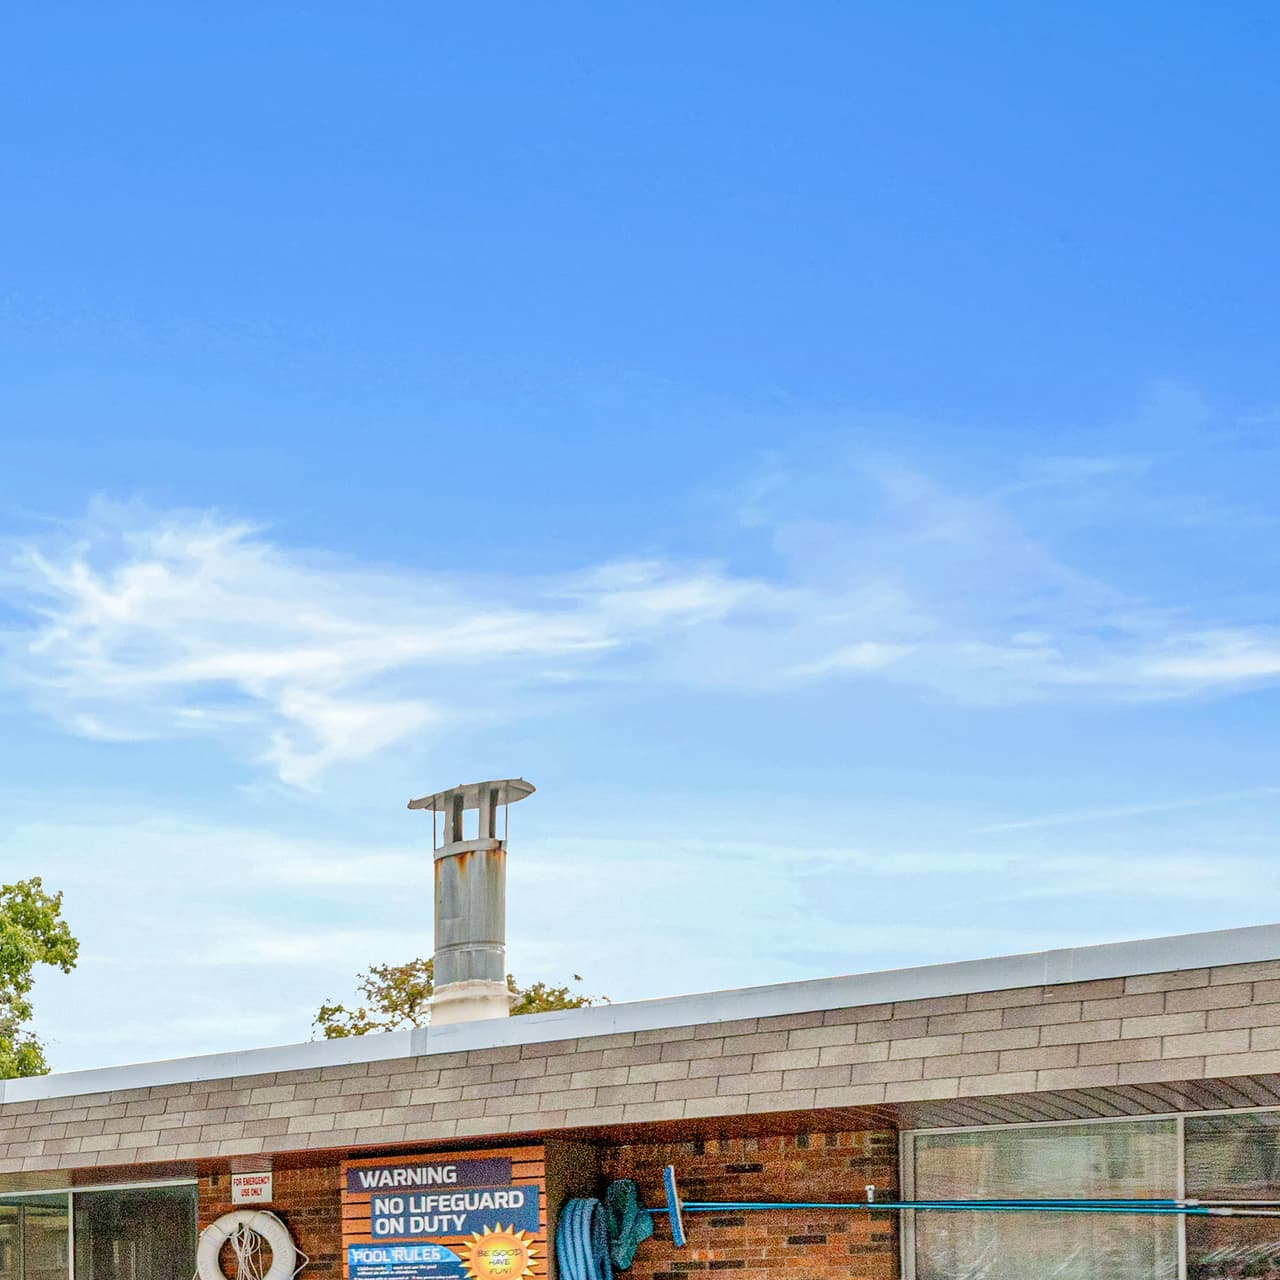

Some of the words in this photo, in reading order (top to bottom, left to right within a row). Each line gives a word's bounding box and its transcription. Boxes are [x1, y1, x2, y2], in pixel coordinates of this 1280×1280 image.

[359, 1166, 457, 1188] WARNING
[375, 1197, 404, 1215] NO
[410, 1191, 525, 1213] LIFEGUARD
[375, 1218, 404, 1235] ON
[410, 1214, 467, 1233] DUTY
[353, 1249, 391, 1263] POOL
[393, 1247, 441, 1261] RULES
[478, 1249, 489, 1257] BE
[489, 1258, 511, 1266] HAVE
